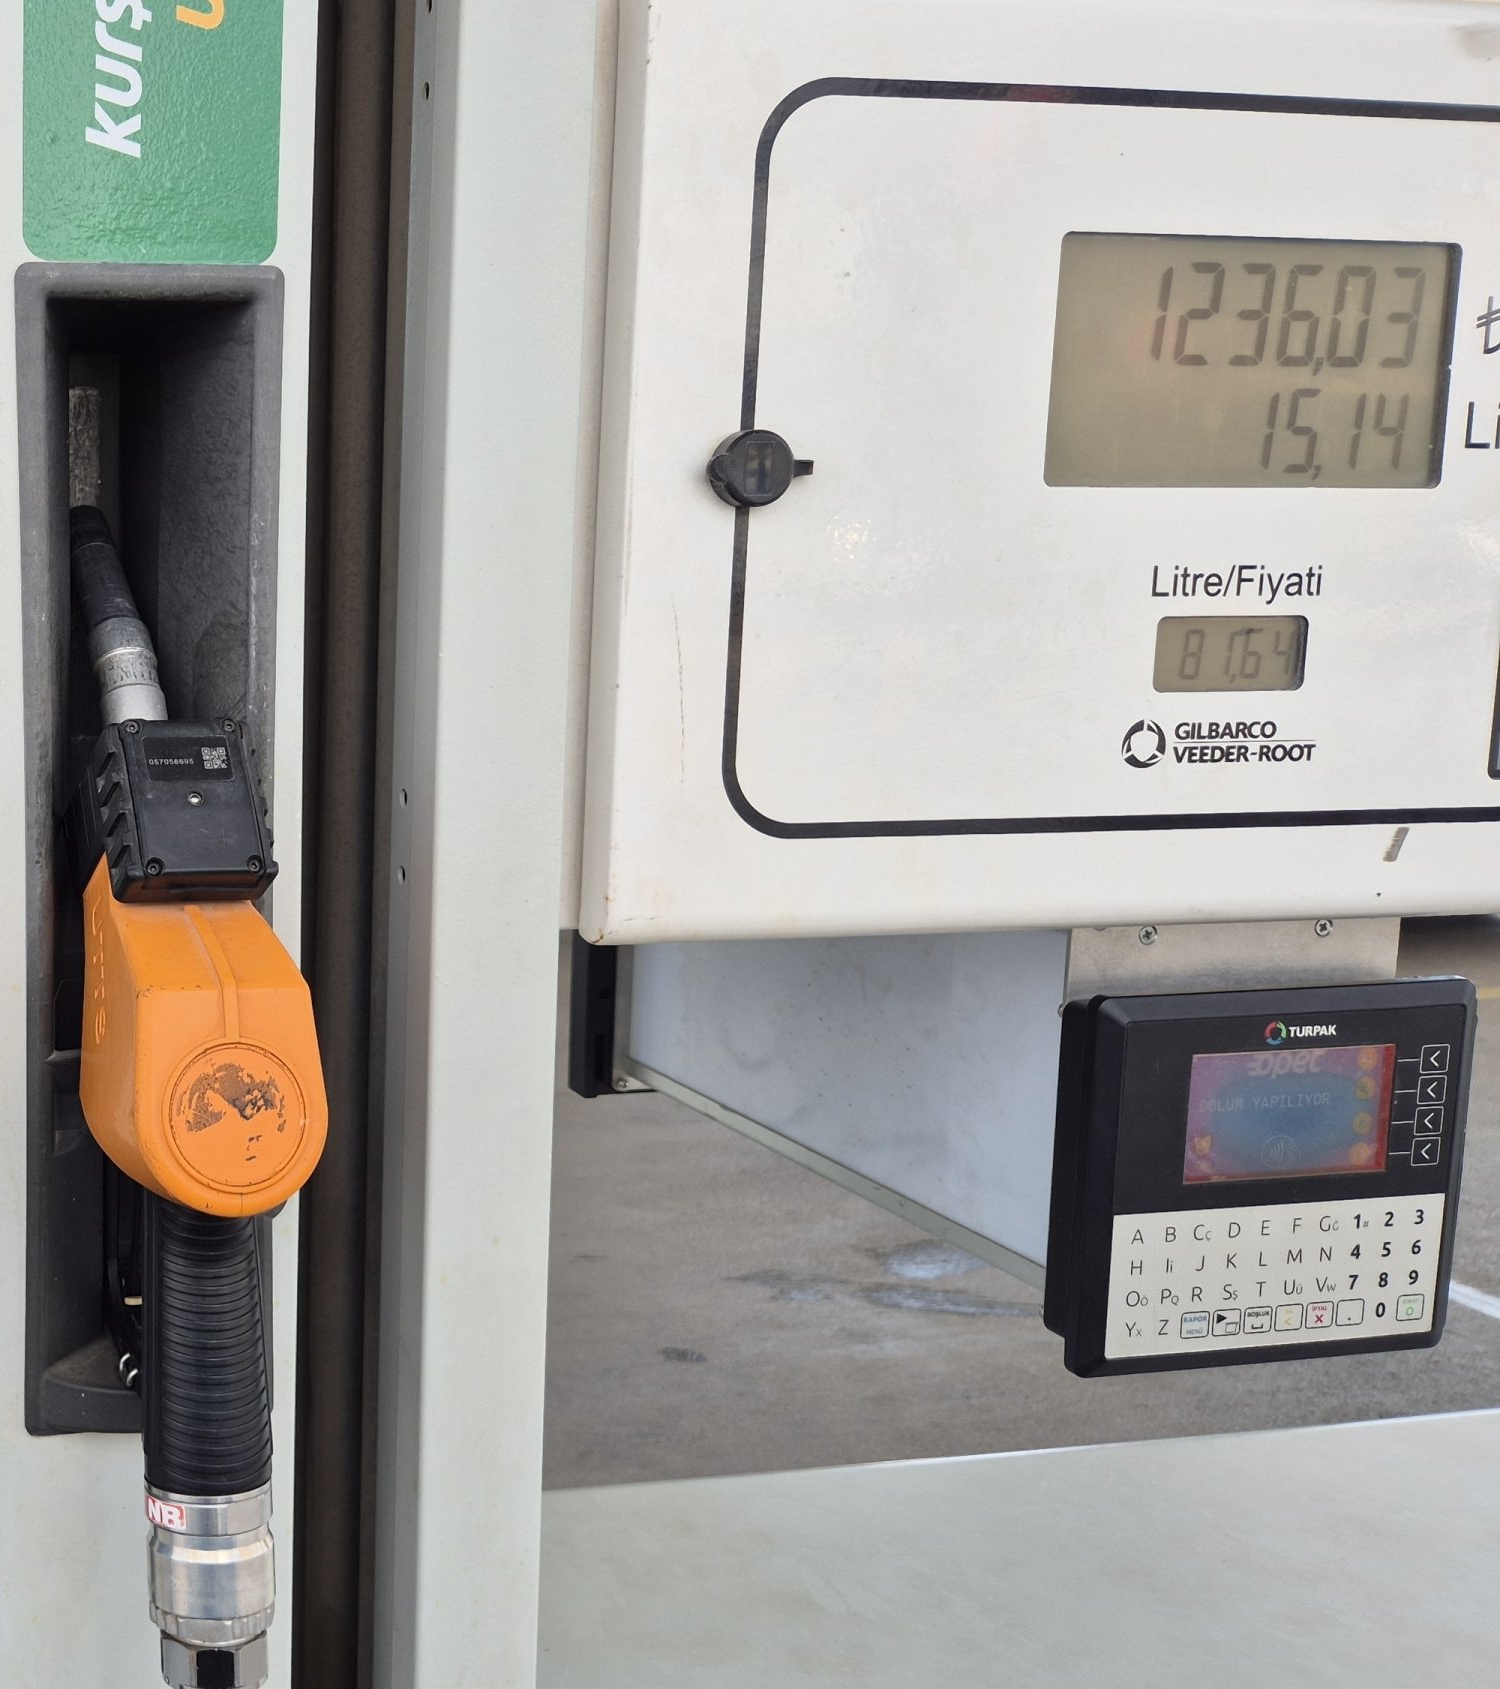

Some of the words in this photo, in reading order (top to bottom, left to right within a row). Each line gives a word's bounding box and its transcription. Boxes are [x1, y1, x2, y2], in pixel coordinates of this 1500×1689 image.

[1151, 262, 1425, 376] 1236,03
[1261, 388, 1409, 480] 15,14
[1151, 564, 1323, 605] Litre/Fiyati
[1174, 720, 1277, 741] GILBARCO
[1173, 743, 1316, 764] VEEDER-ROOT
[1289, 1024, 1337, 1038] TURPAK
[1131, 1229, 1144, 1245] A
[1165, 1226, 1177, 1243] B
[1228, 1222, 1241, 1239] D
[1261, 1220, 1271, 1236] E
[1292, 1218, 1303, 1234] F
[1384, 1212, 1394, 1227] 2
[1414, 1209, 1424, 1225] 3
[1130, 1260, 1143, 1276] H
[1195, 1255, 1205, 1272] J
[1226, 1253, 1237, 1269] K
[1258, 1251, 1268, 1267] L
[1287, 1248, 1302, 1265] M
[1320, 1246, 1332, 1263] N
[1350, 1244, 1361, 1260] 4
[1381, 1242, 1392, 1258] 5
[1411, 1239, 1421, 1255] 6
[1191, 1286, 1203, 1303] R
[1256, 1281, 1267, 1298] T
[1348, 1274, 1359, 1291] 7
[1378, 1272, 1389, 1288] 8
[1408, 1270, 1419, 1286] 9
[1158, 1320, 1169, 1336] Z
[1375, 1302, 1386, 1318] 0
[1184, 1315, 1208, 1324] RAPOR
